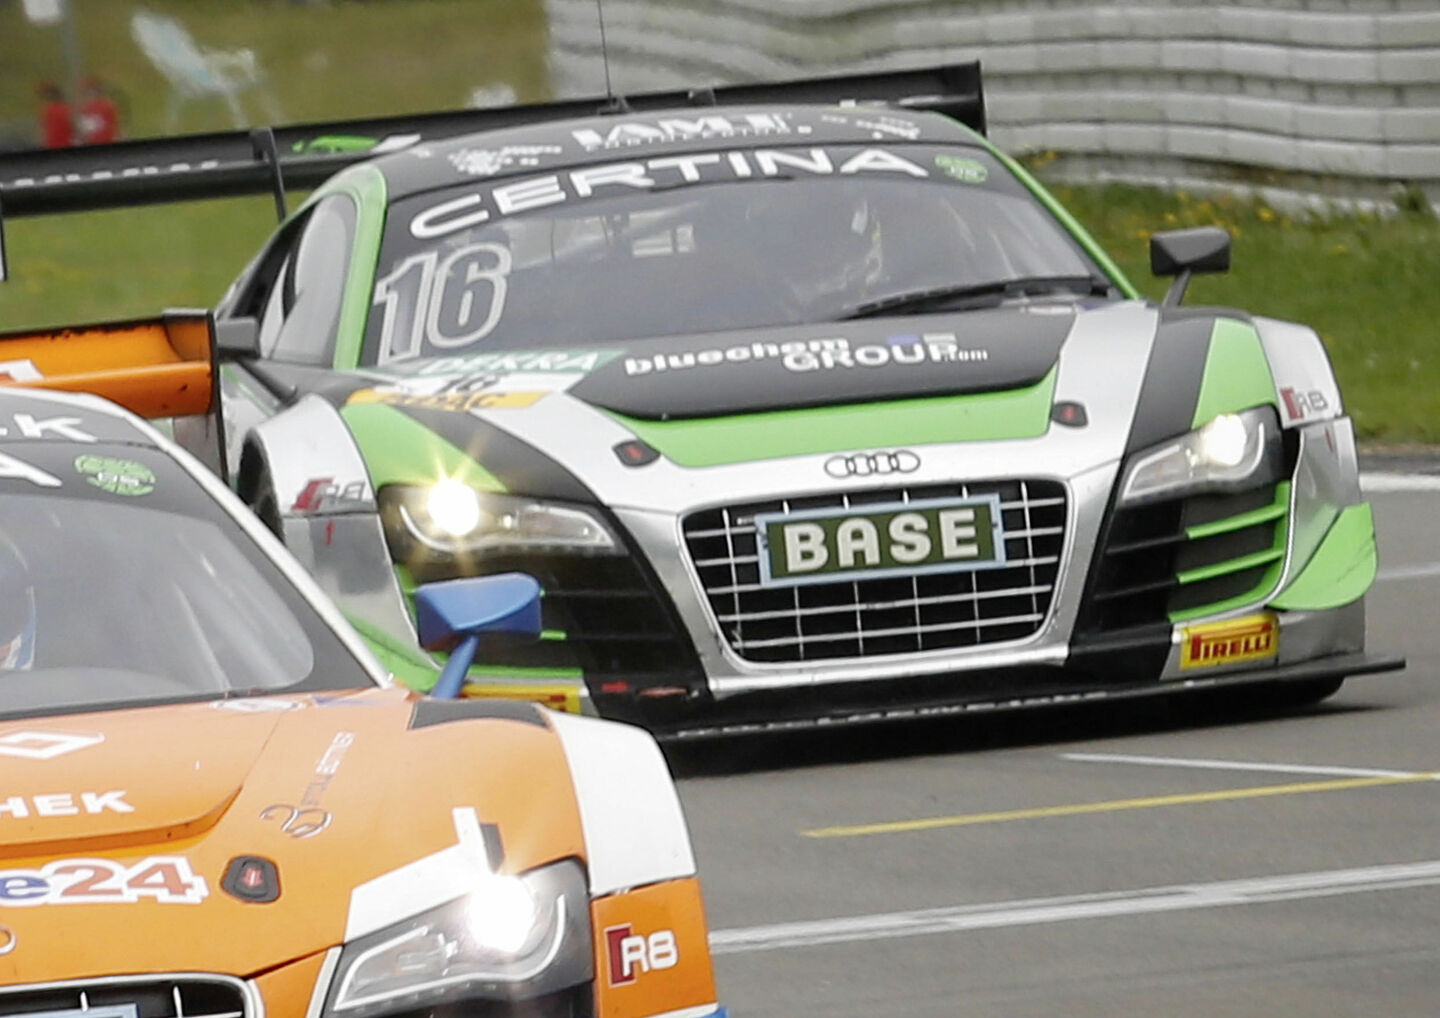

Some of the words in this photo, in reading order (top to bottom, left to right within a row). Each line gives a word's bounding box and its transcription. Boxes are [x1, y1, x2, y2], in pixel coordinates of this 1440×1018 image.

[410, 148, 929, 239] CERTINA
[373, 241, 512, 367] 16
[783, 508, 979, 573] BASE
[1189, 621, 1273, 661] PIRELLI
[619, 929, 679, 976] R8
